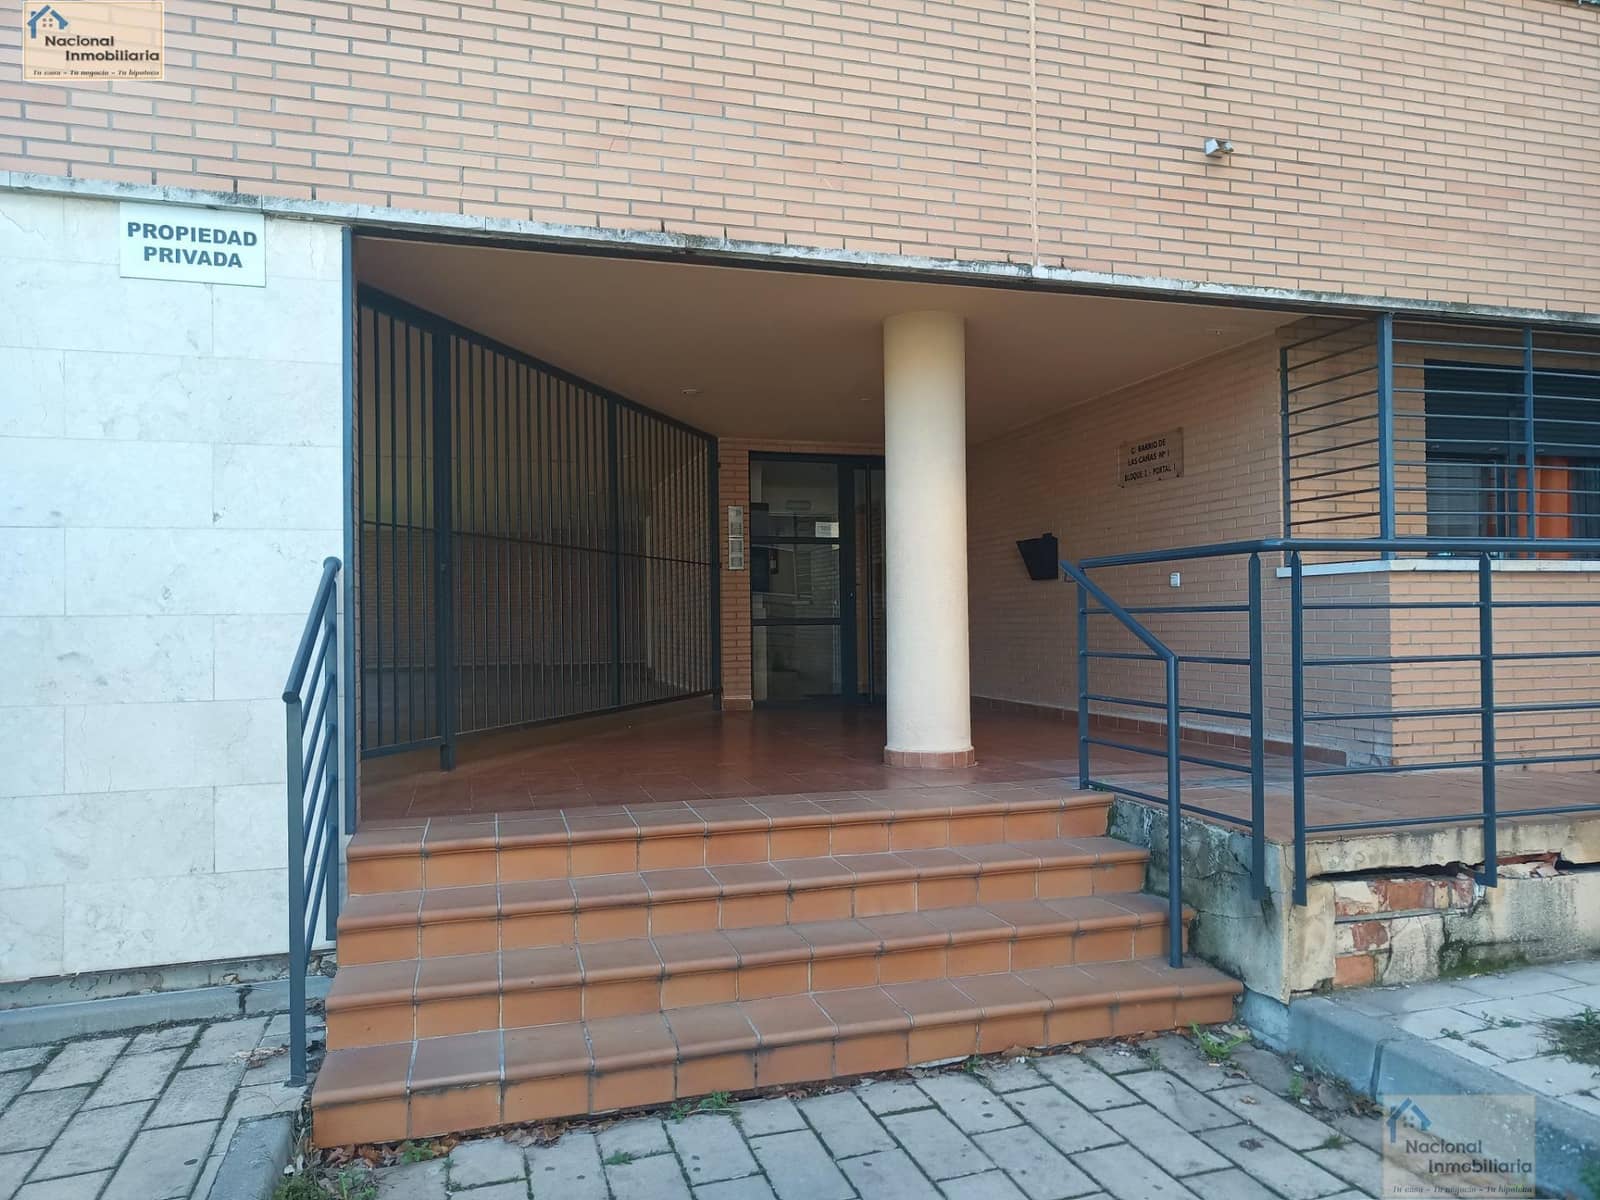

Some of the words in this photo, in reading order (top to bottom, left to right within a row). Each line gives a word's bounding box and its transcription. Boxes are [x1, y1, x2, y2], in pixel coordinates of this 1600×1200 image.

[127, 221, 258, 247] PROPIEDAD
[143, 245, 243, 268] PRIVADA
[1137, 441, 1157, 453] BARRIO
[1158, 438, 1166, 447] DE
[1127, 457, 1138, 467] LAS
